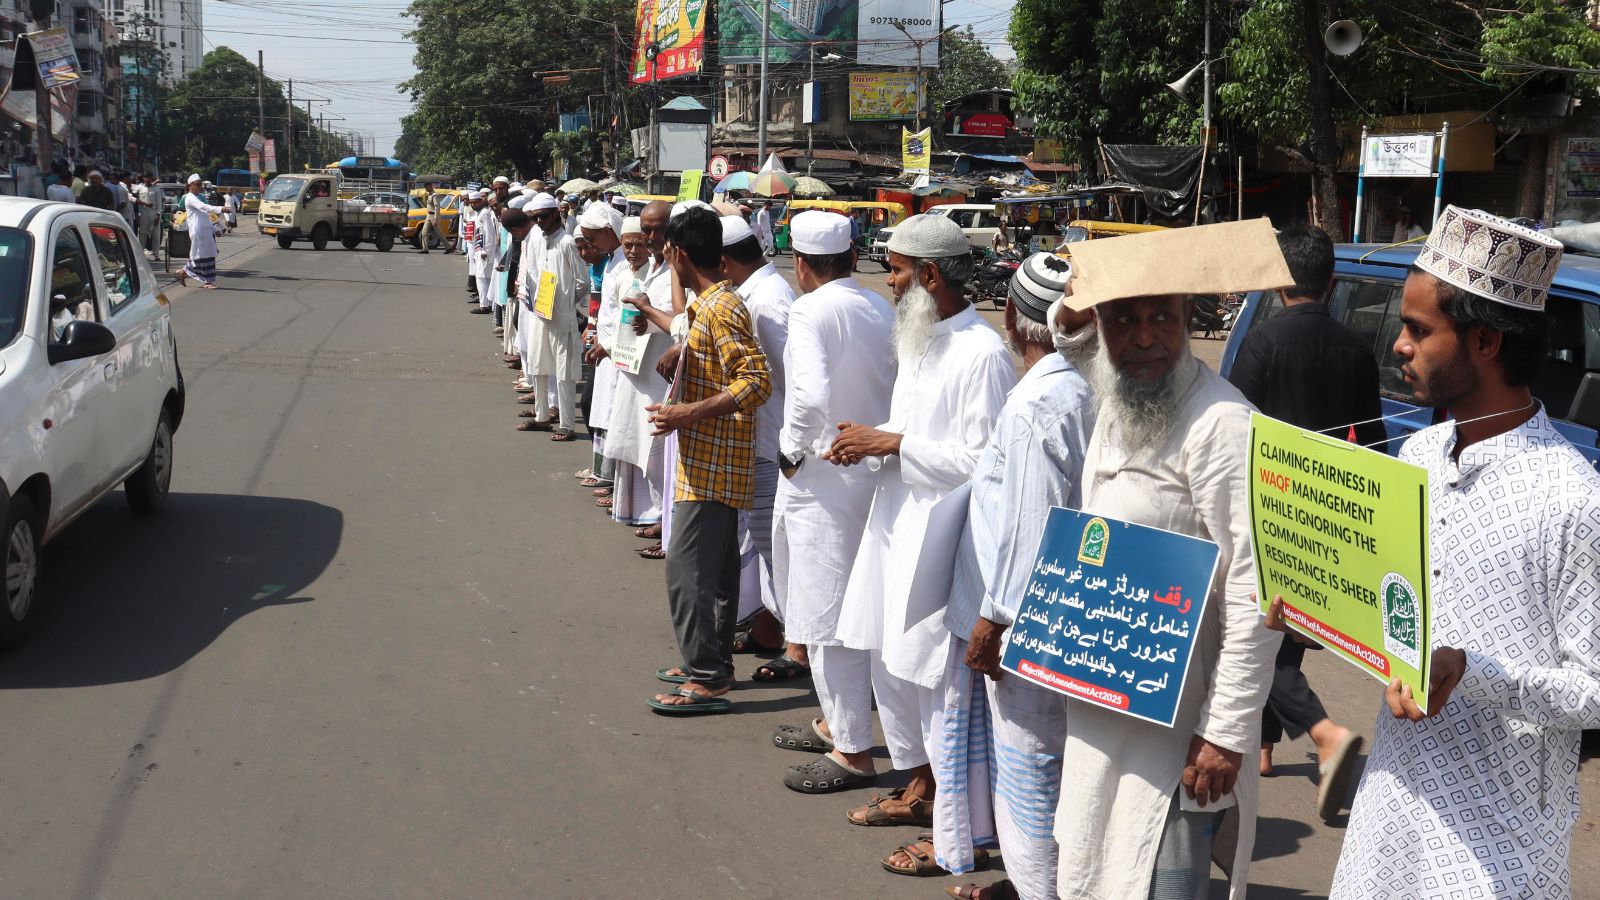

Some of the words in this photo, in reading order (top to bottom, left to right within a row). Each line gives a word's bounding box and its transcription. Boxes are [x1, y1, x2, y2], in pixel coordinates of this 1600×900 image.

[901, 17, 932, 26] 68000
[1383, 140, 1417, 154] উত্তরণ
[1260, 441, 1310, 473] CLAIMING
[1312, 459, 1365, 494] FAIRNESS
[1367, 479, 1381, 499] IN
[1260, 469, 1290, 493] WAQF
[1292, 479, 1375, 526] MANAGEMENT
[1260, 493, 1294, 521] WHILE
[1295, 506, 1352, 545] IGNORING
[1353, 530, 1377, 555] THE
[1041, 558, 1065, 577] مسلموں
[1065, 564, 1083, 584] غیر
[1266, 544, 1327, 585] RESISTANCE
[1329, 569, 1339, 588] IS
[1341, 575, 1378, 608] SHEER
[1085, 576, 1107, 590] میں
[1109, 573, 1150, 604] بورڈز
[1270, 568, 1331, 612] HYPOCRISY.
[1044, 587, 1059, 605] اور
[1059, 591, 1085, 610] مقصد
[1153, 585, 1192, 614] وقف
[1048, 615, 1064, 634] کی
[1063, 620, 1081, 640] جن
[1149, 614, 1189, 638] شامل
[1025, 636, 1063, 657] مخصوص
[1078, 631, 1099, 648] ہے
[1102, 628, 1129, 652] کرتا
[1130, 643, 1177, 663] کمزور
[1064, 650, 1116, 678] جائیدادیں
[1021, 662, 1123, 705] #RejectWaqfAmendmentAct2025
[1119, 669, 1135, 684] یہ
[1135, 672, 1169, 694] لیے
